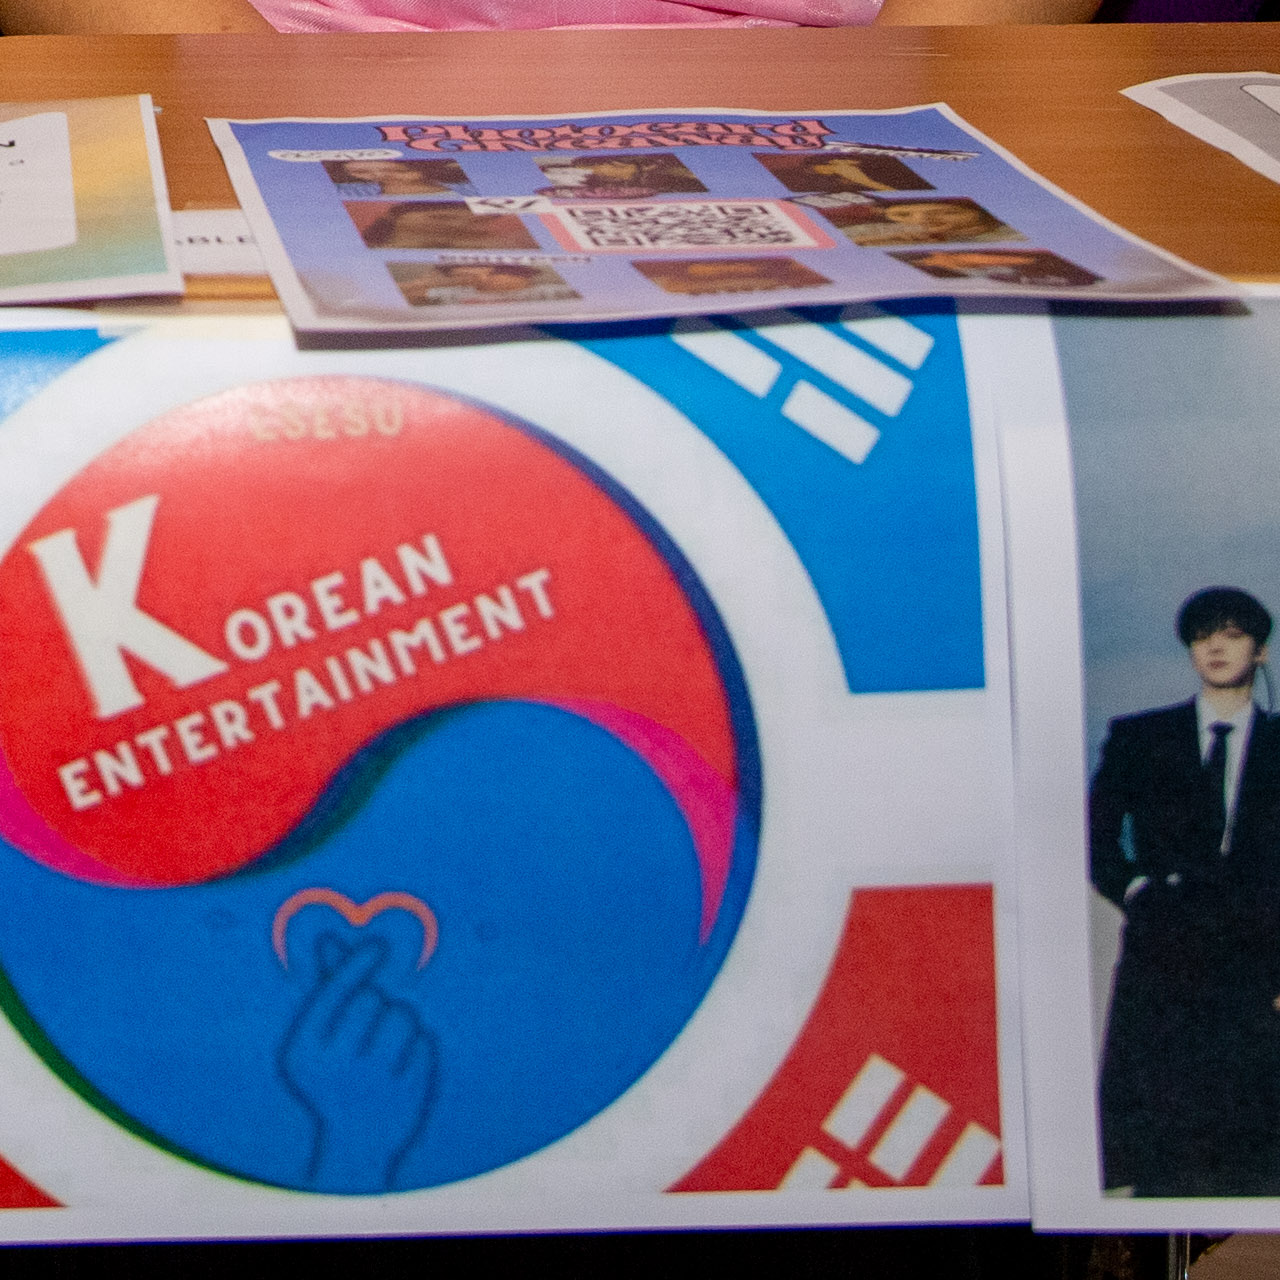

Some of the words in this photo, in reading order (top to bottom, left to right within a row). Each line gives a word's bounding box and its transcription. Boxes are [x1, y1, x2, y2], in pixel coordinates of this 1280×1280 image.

[377, 120, 835, 142] Photocard
[26, 495, 453, 719] KOREAN
[56, 570, 554, 811] ENTERTAINMENT
